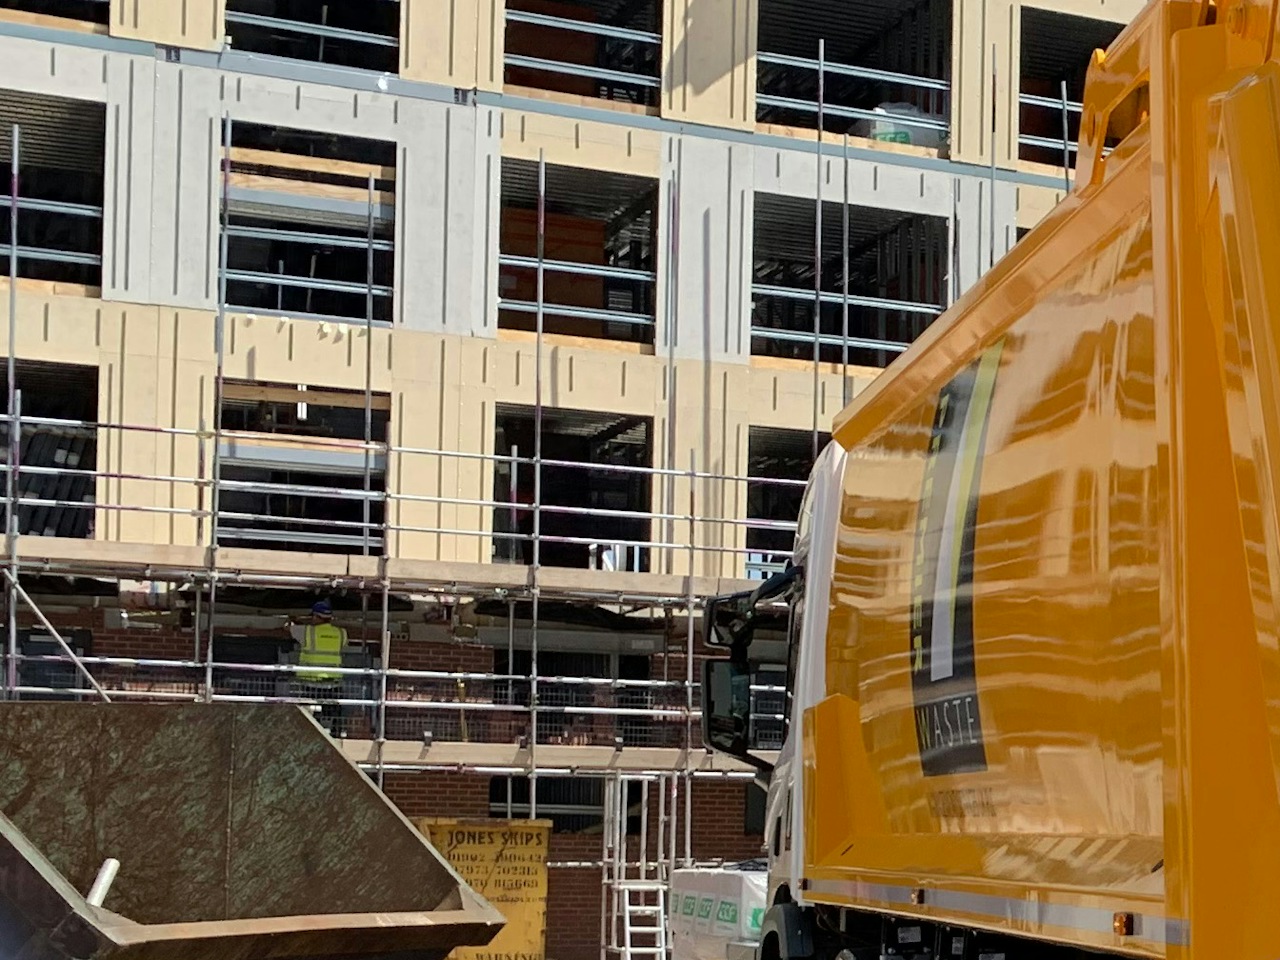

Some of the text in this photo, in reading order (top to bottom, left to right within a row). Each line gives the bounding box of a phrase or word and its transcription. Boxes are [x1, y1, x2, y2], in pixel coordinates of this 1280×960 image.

[913, 393, 950, 673] PREMIER
[917, 697, 978, 750] WASTE
[447, 830, 543, 847] JONES SKIPS
